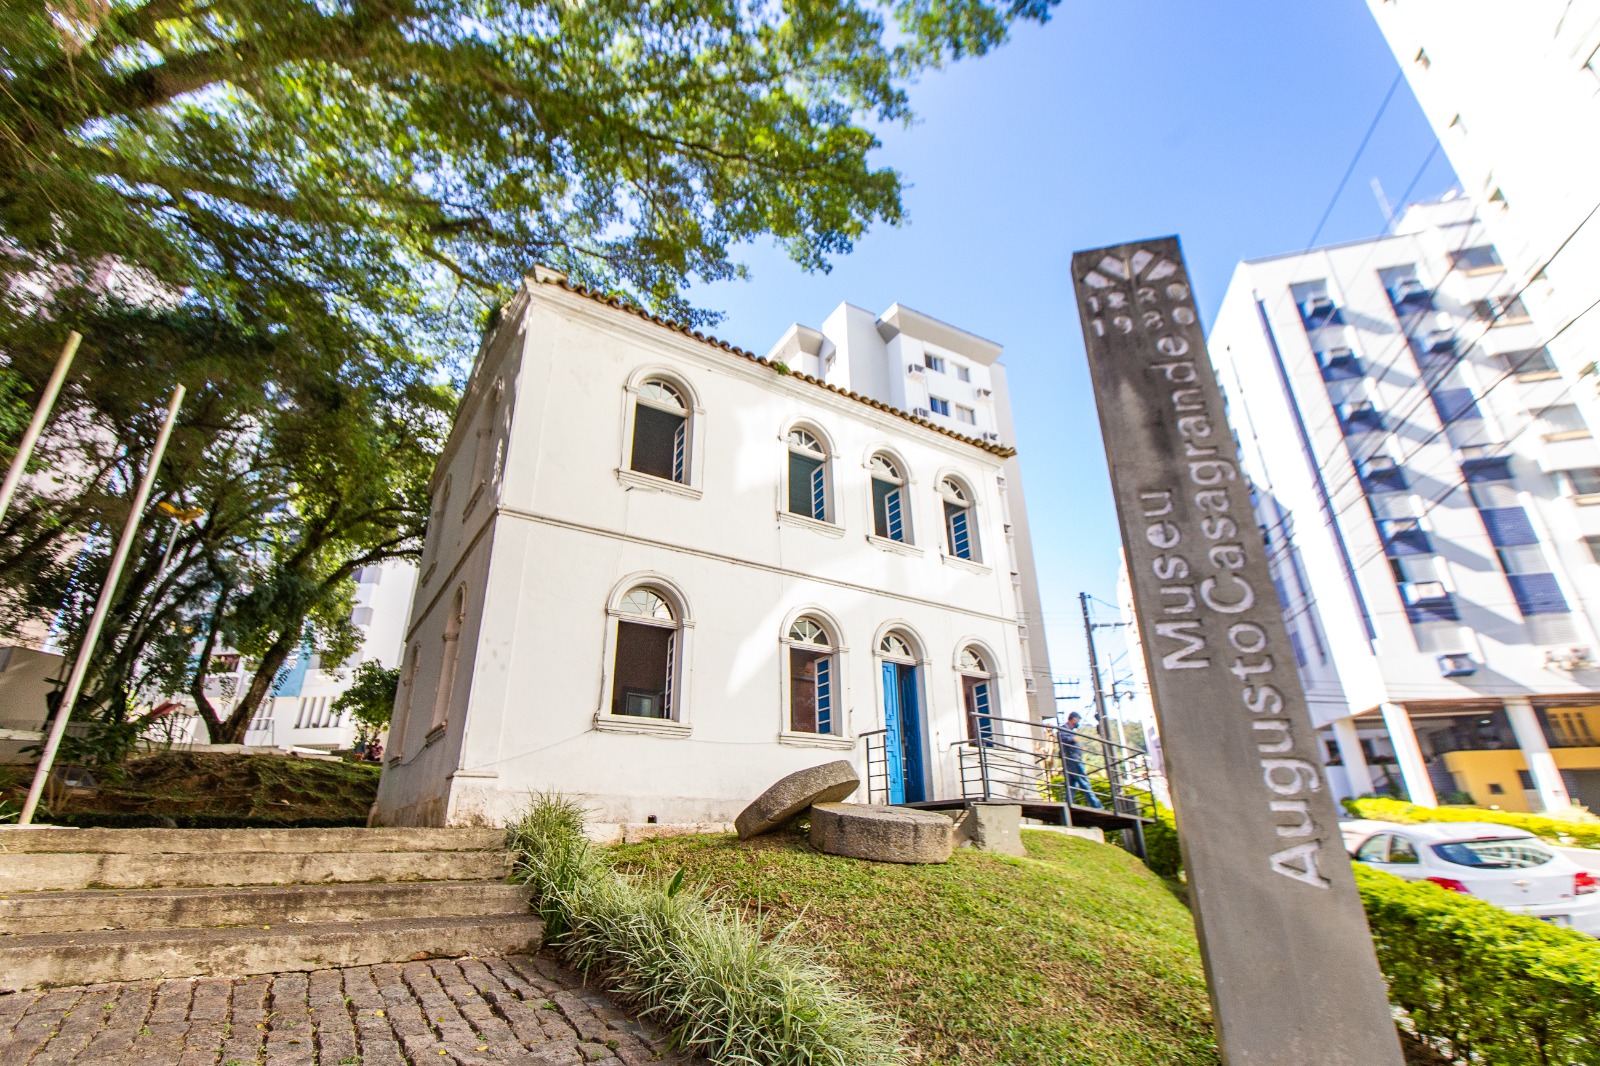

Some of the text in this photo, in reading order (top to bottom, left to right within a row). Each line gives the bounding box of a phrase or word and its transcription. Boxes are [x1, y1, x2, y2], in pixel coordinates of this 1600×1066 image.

[1140, 489, 1210, 670] Museu
[1150, 335, 1331, 890] Augusto Casagrande
